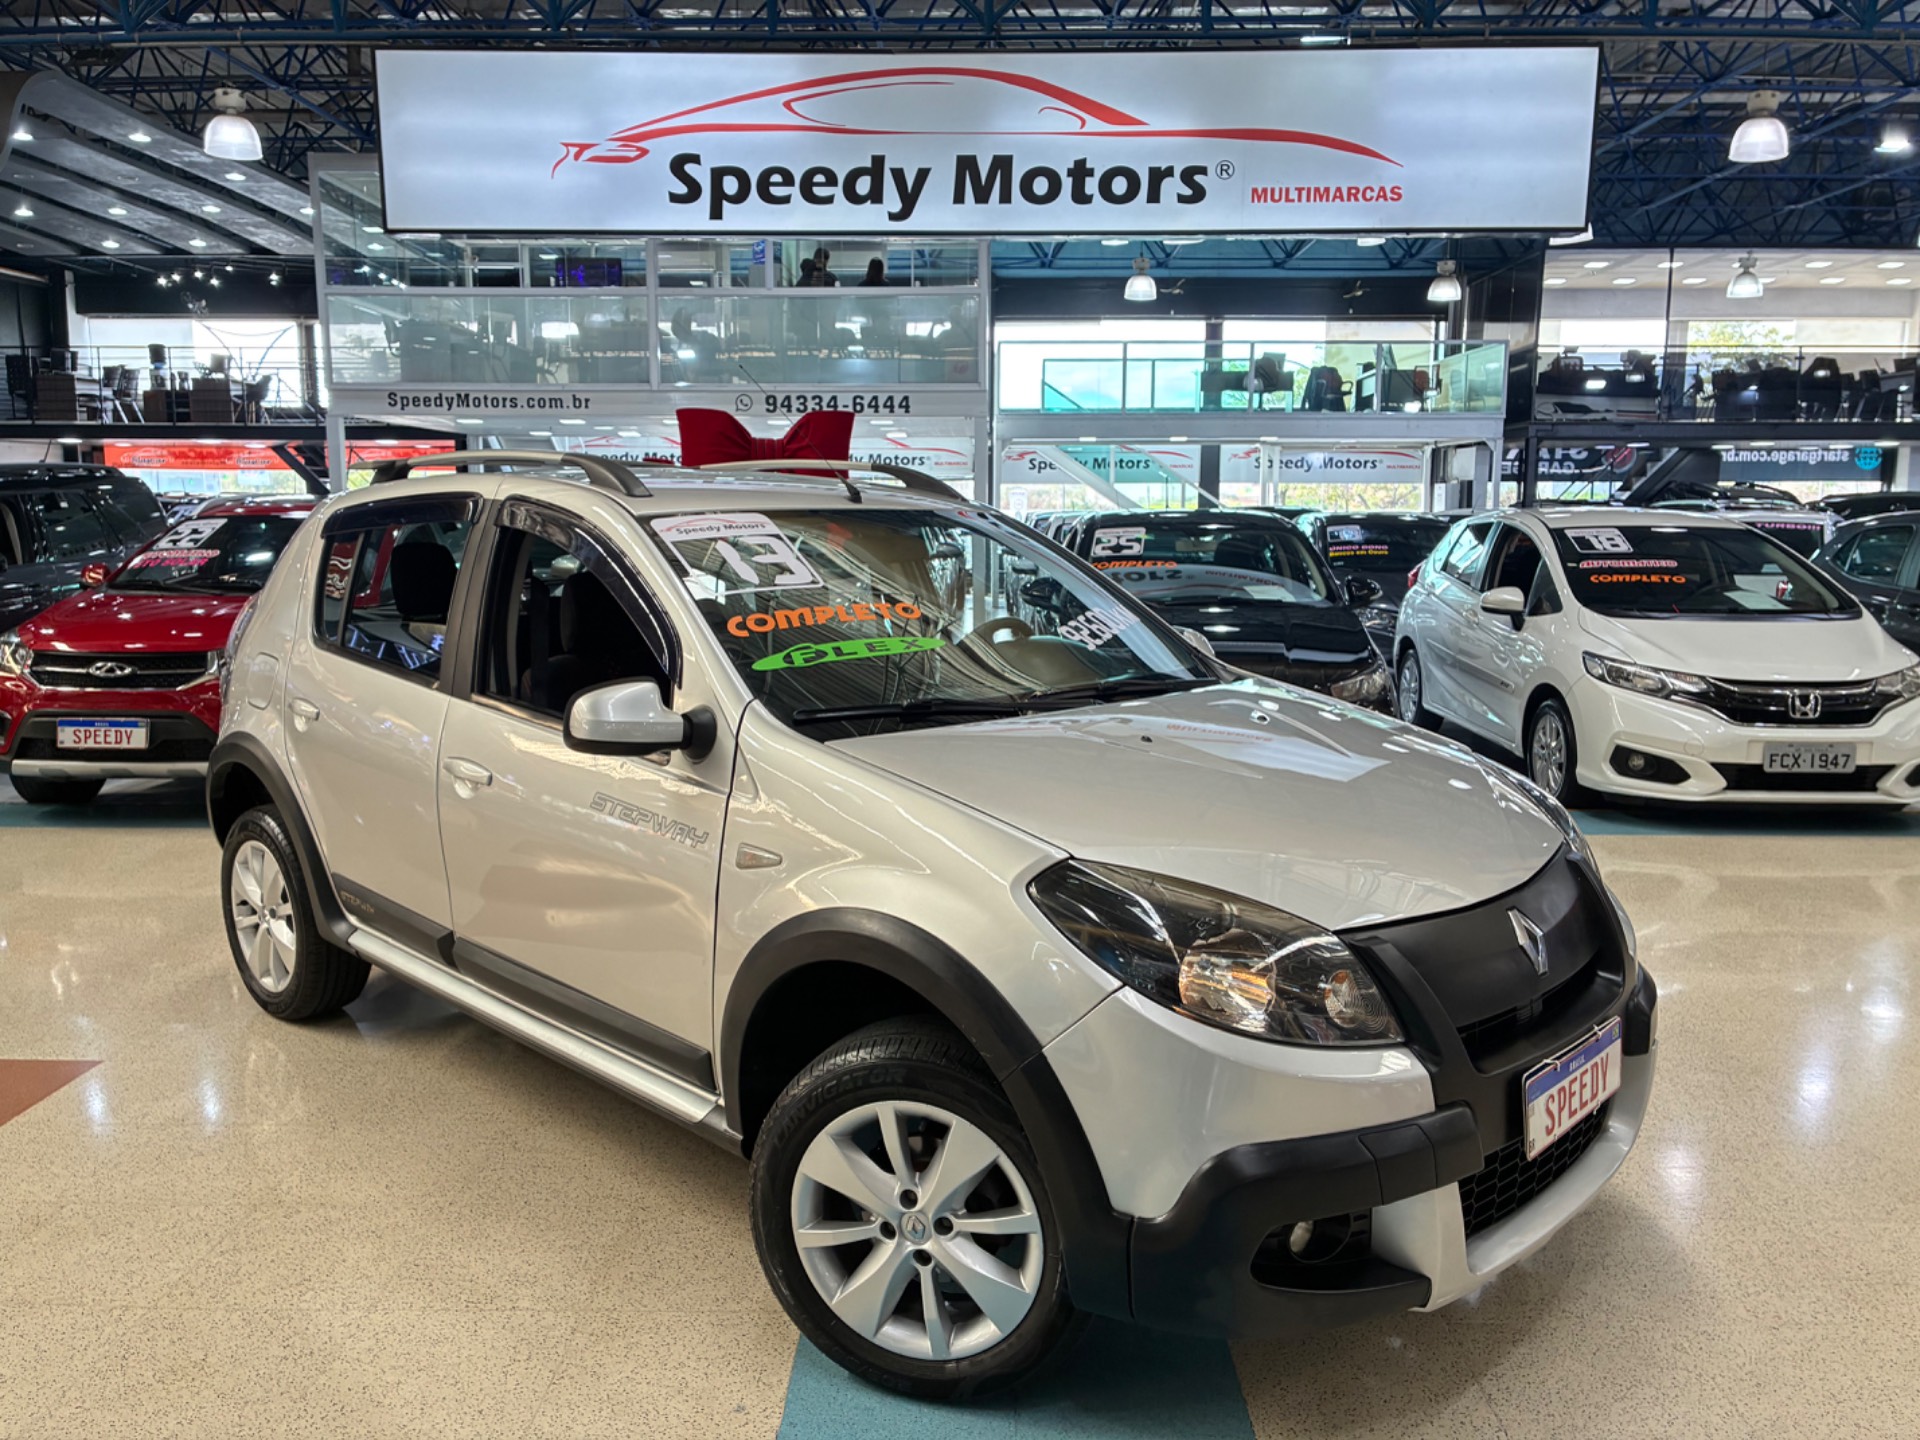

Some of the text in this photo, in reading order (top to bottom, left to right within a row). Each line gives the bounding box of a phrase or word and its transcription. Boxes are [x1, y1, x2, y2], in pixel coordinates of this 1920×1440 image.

[668, 153, 931, 221] Speedy
[953, 154, 1208, 205] Motors
[1250, 185, 1403, 204] MULTIMARCAS
[387, 391, 591, 412] SpeedyMotors.com.br
[764, 394, 911, 414] 94334-6444
[1028, 457, 1151, 474] Spe Mtors
[1095, 535, 1141, 554] 25
[1584, 535, 1629, 551] 18
[715, 535, 812, 586] 13
[1590, 574, 1686, 583] COMPLETO
[727, 602, 921, 637] COMPLETO
[783, 638, 924, 666] FLEX
[73, 728, 133, 745] SPEEDY
[589, 791, 710, 849] STEPWAY
[1544, 1052, 1609, 1137] SPEEDY
